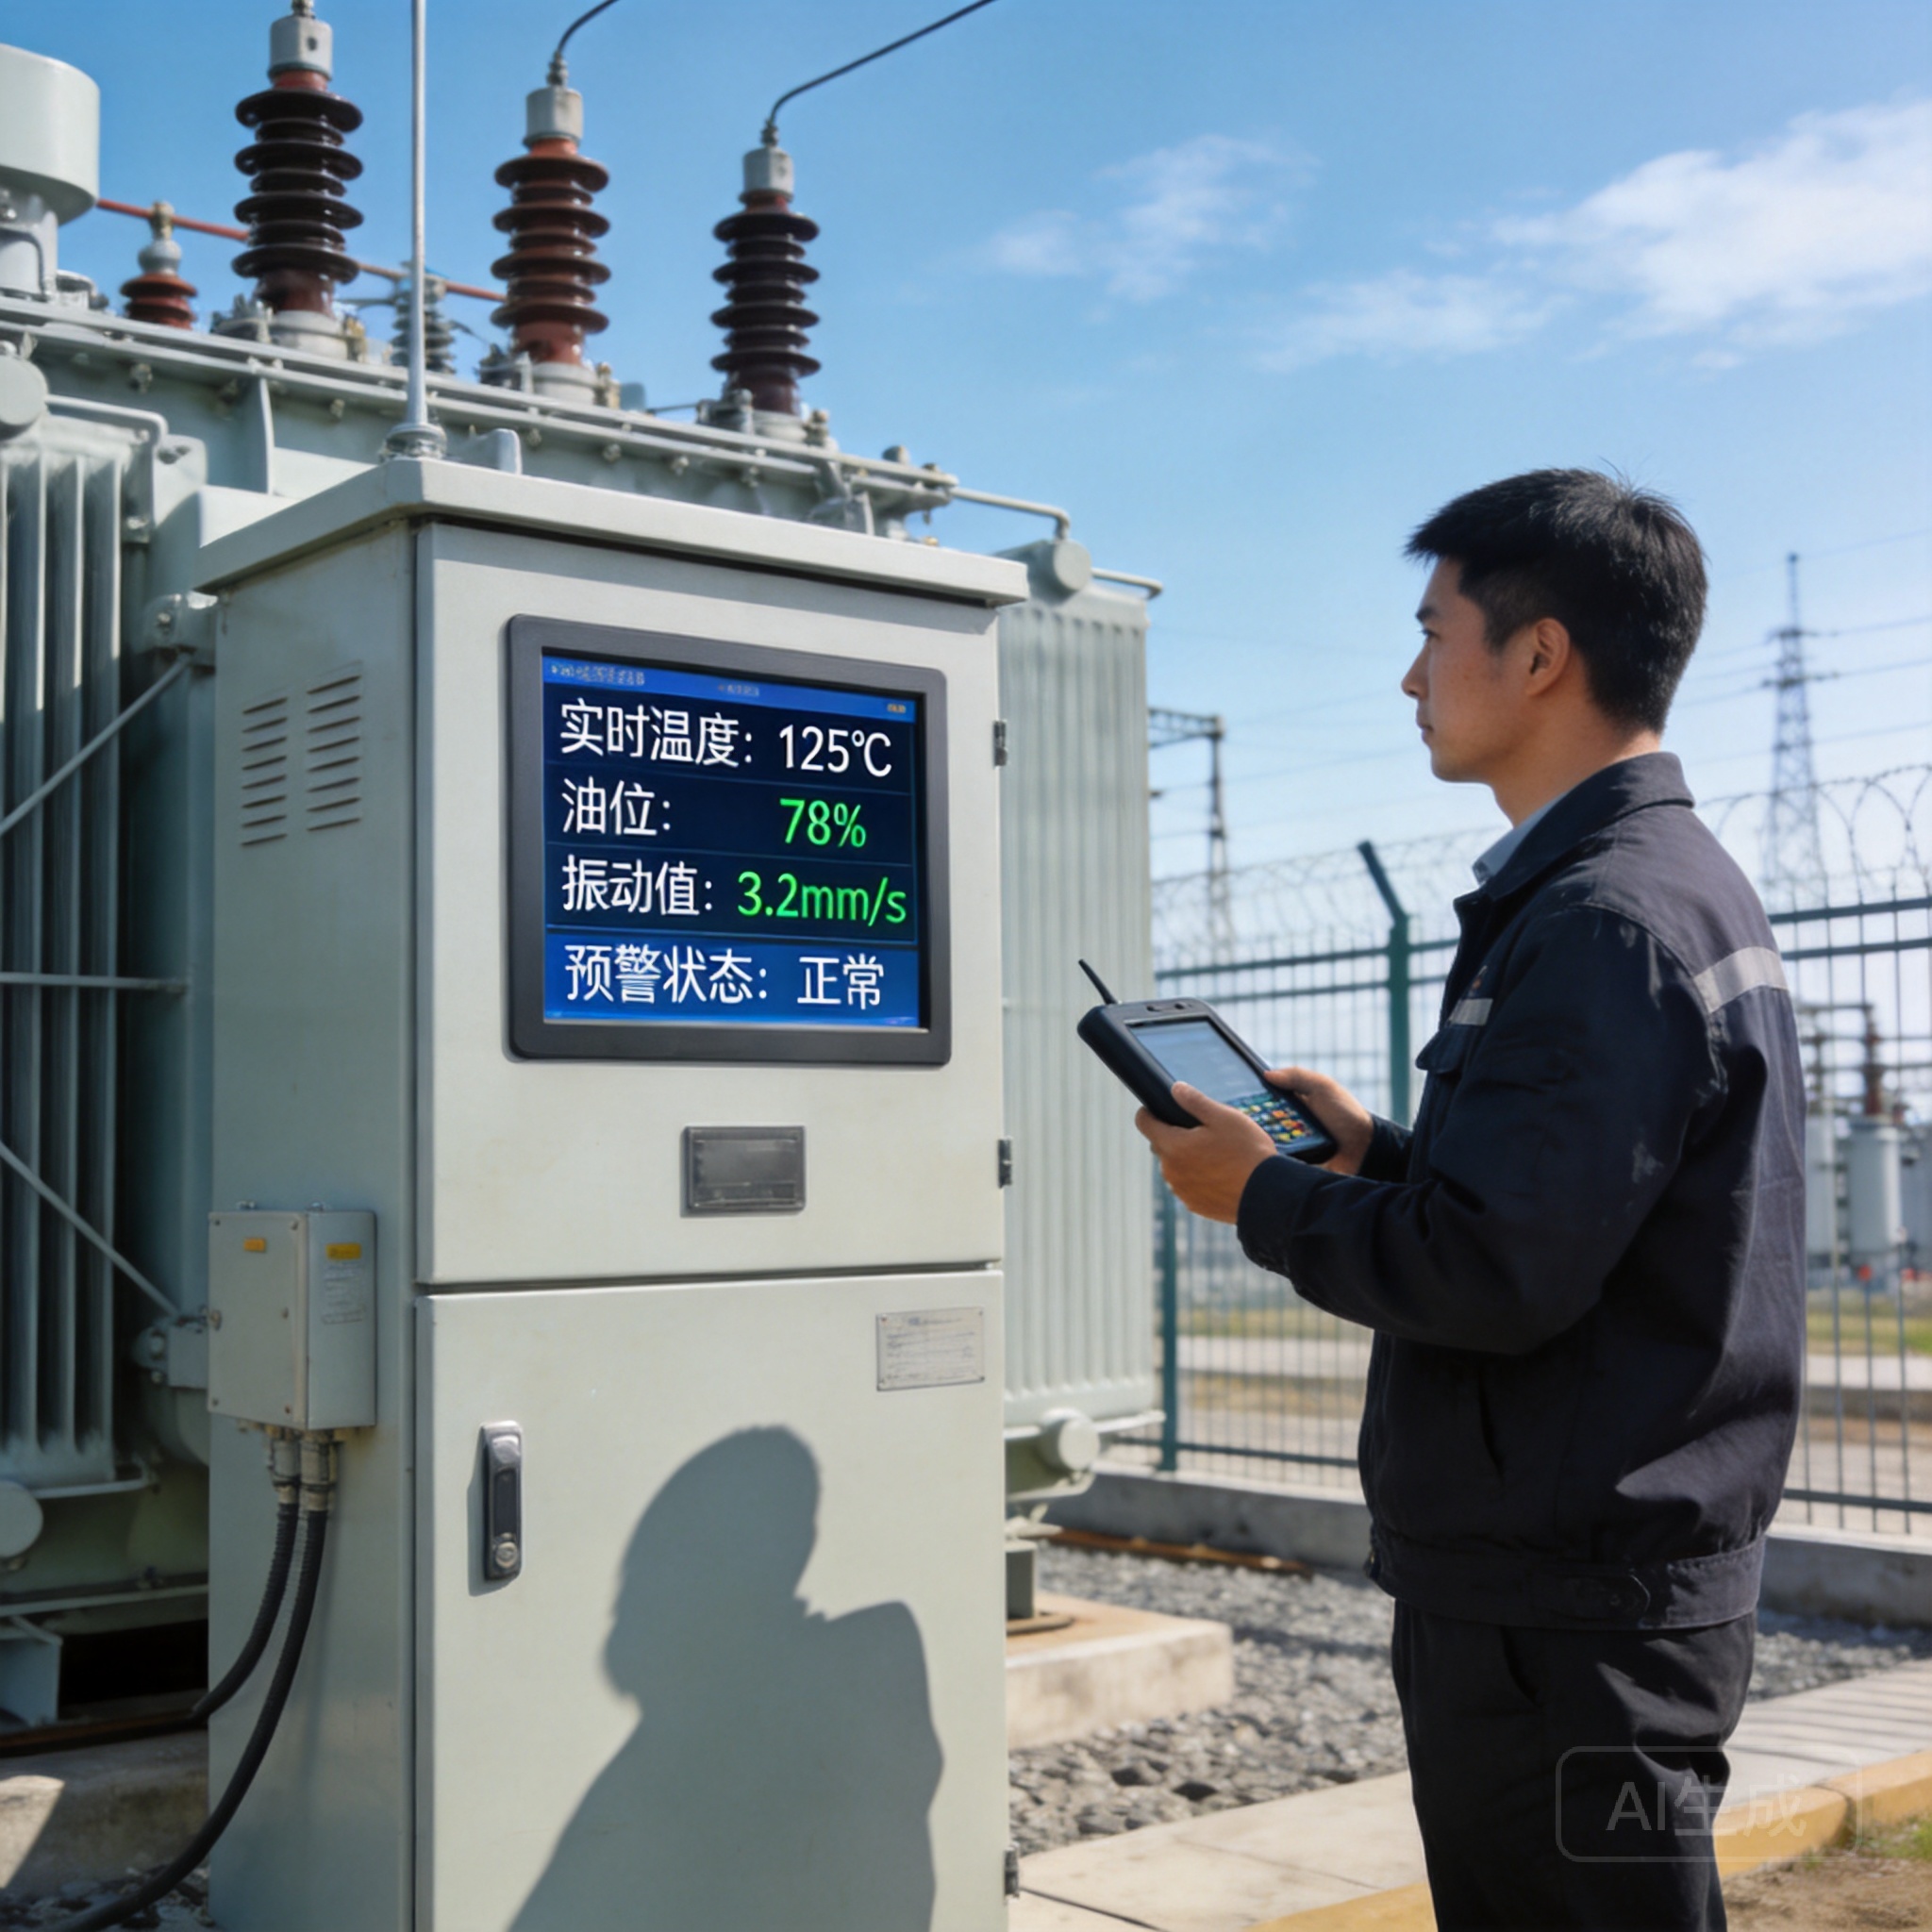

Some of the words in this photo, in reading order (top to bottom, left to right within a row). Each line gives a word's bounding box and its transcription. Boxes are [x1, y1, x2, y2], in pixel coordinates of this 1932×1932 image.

[559, 698, 753, 768] 实时温度：
[561, 775, 671, 836] 油位：
[779, 797, 866, 848] 78%
[561, 855, 713, 917] 振动值：
[737, 871, 907, 926] 3.2mm/s
[565, 944, 767, 1005] 预警状态：
[797, 954, 884, 1010] 正常
